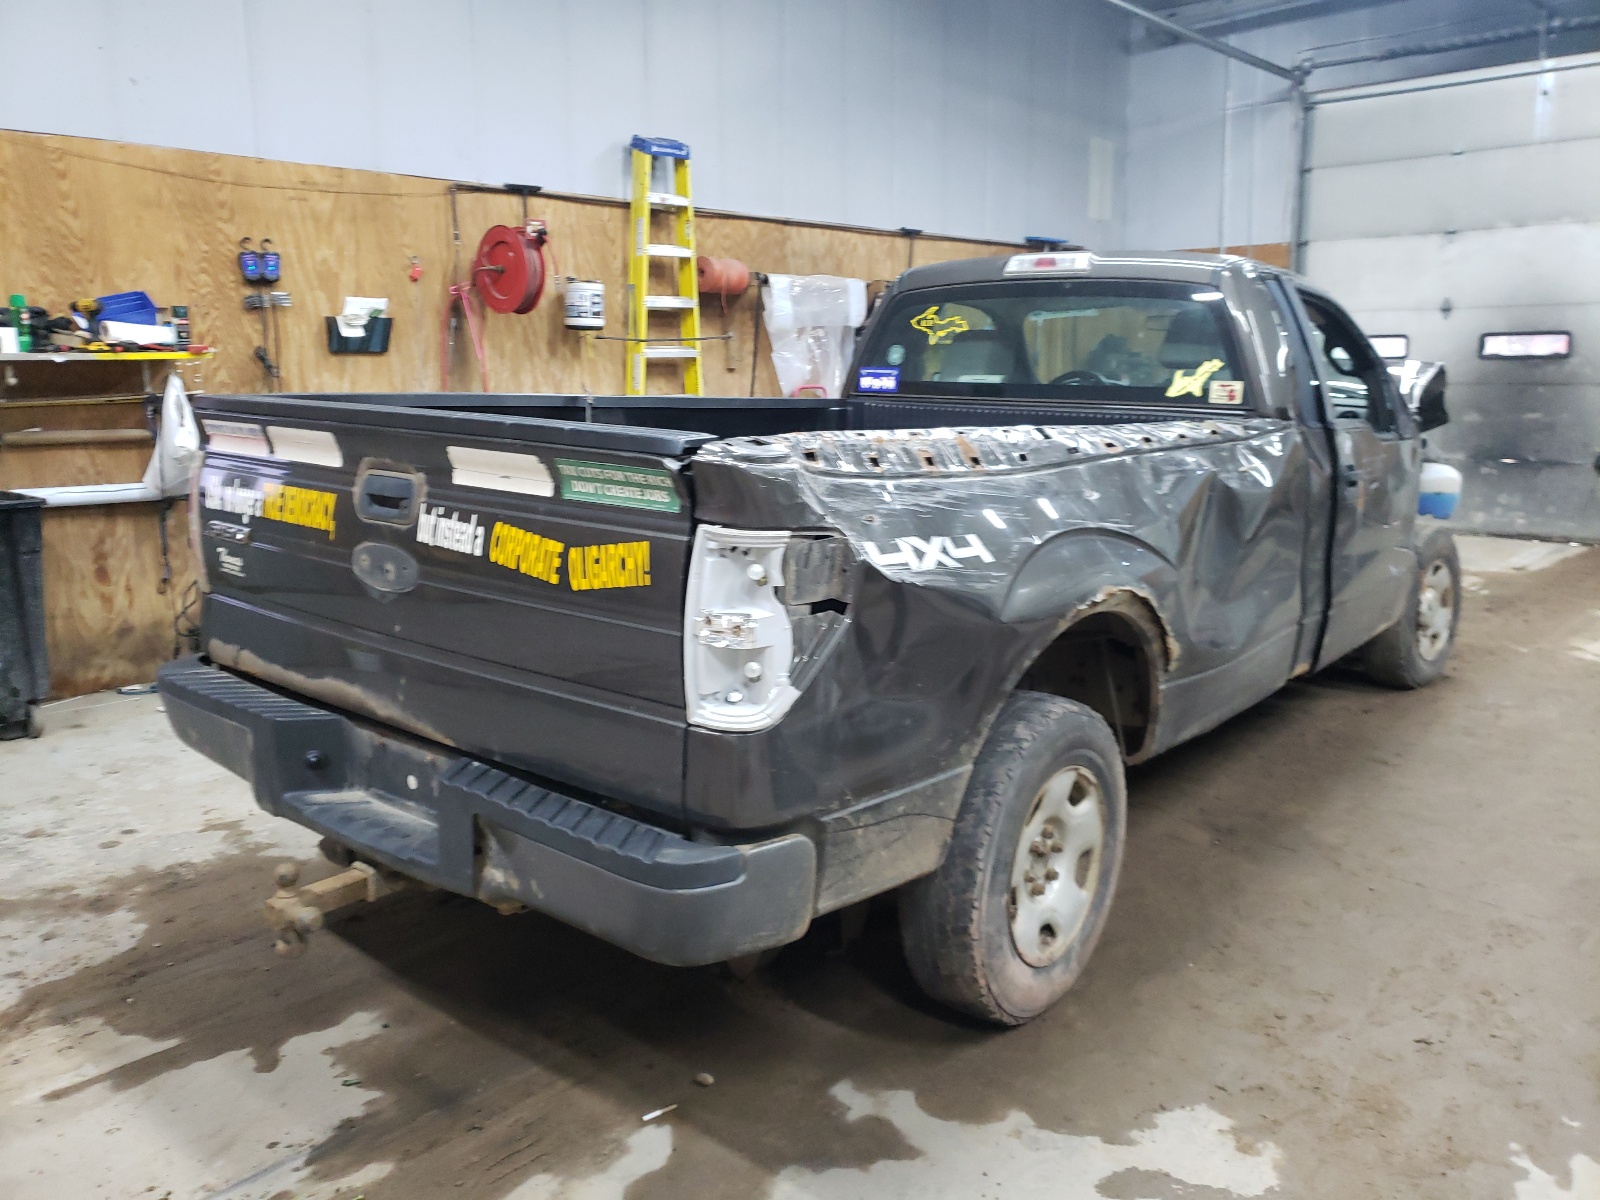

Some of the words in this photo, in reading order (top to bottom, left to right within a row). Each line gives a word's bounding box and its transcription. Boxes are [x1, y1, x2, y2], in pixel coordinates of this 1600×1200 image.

[626, 471, 646, 484] THE
[604, 484, 643, 499] CREATE
[643, 488, 671, 502] JOBS
[489, 521, 565, 585] CORPORATE
[568, 541, 651, 591] OLIGARCHY!
